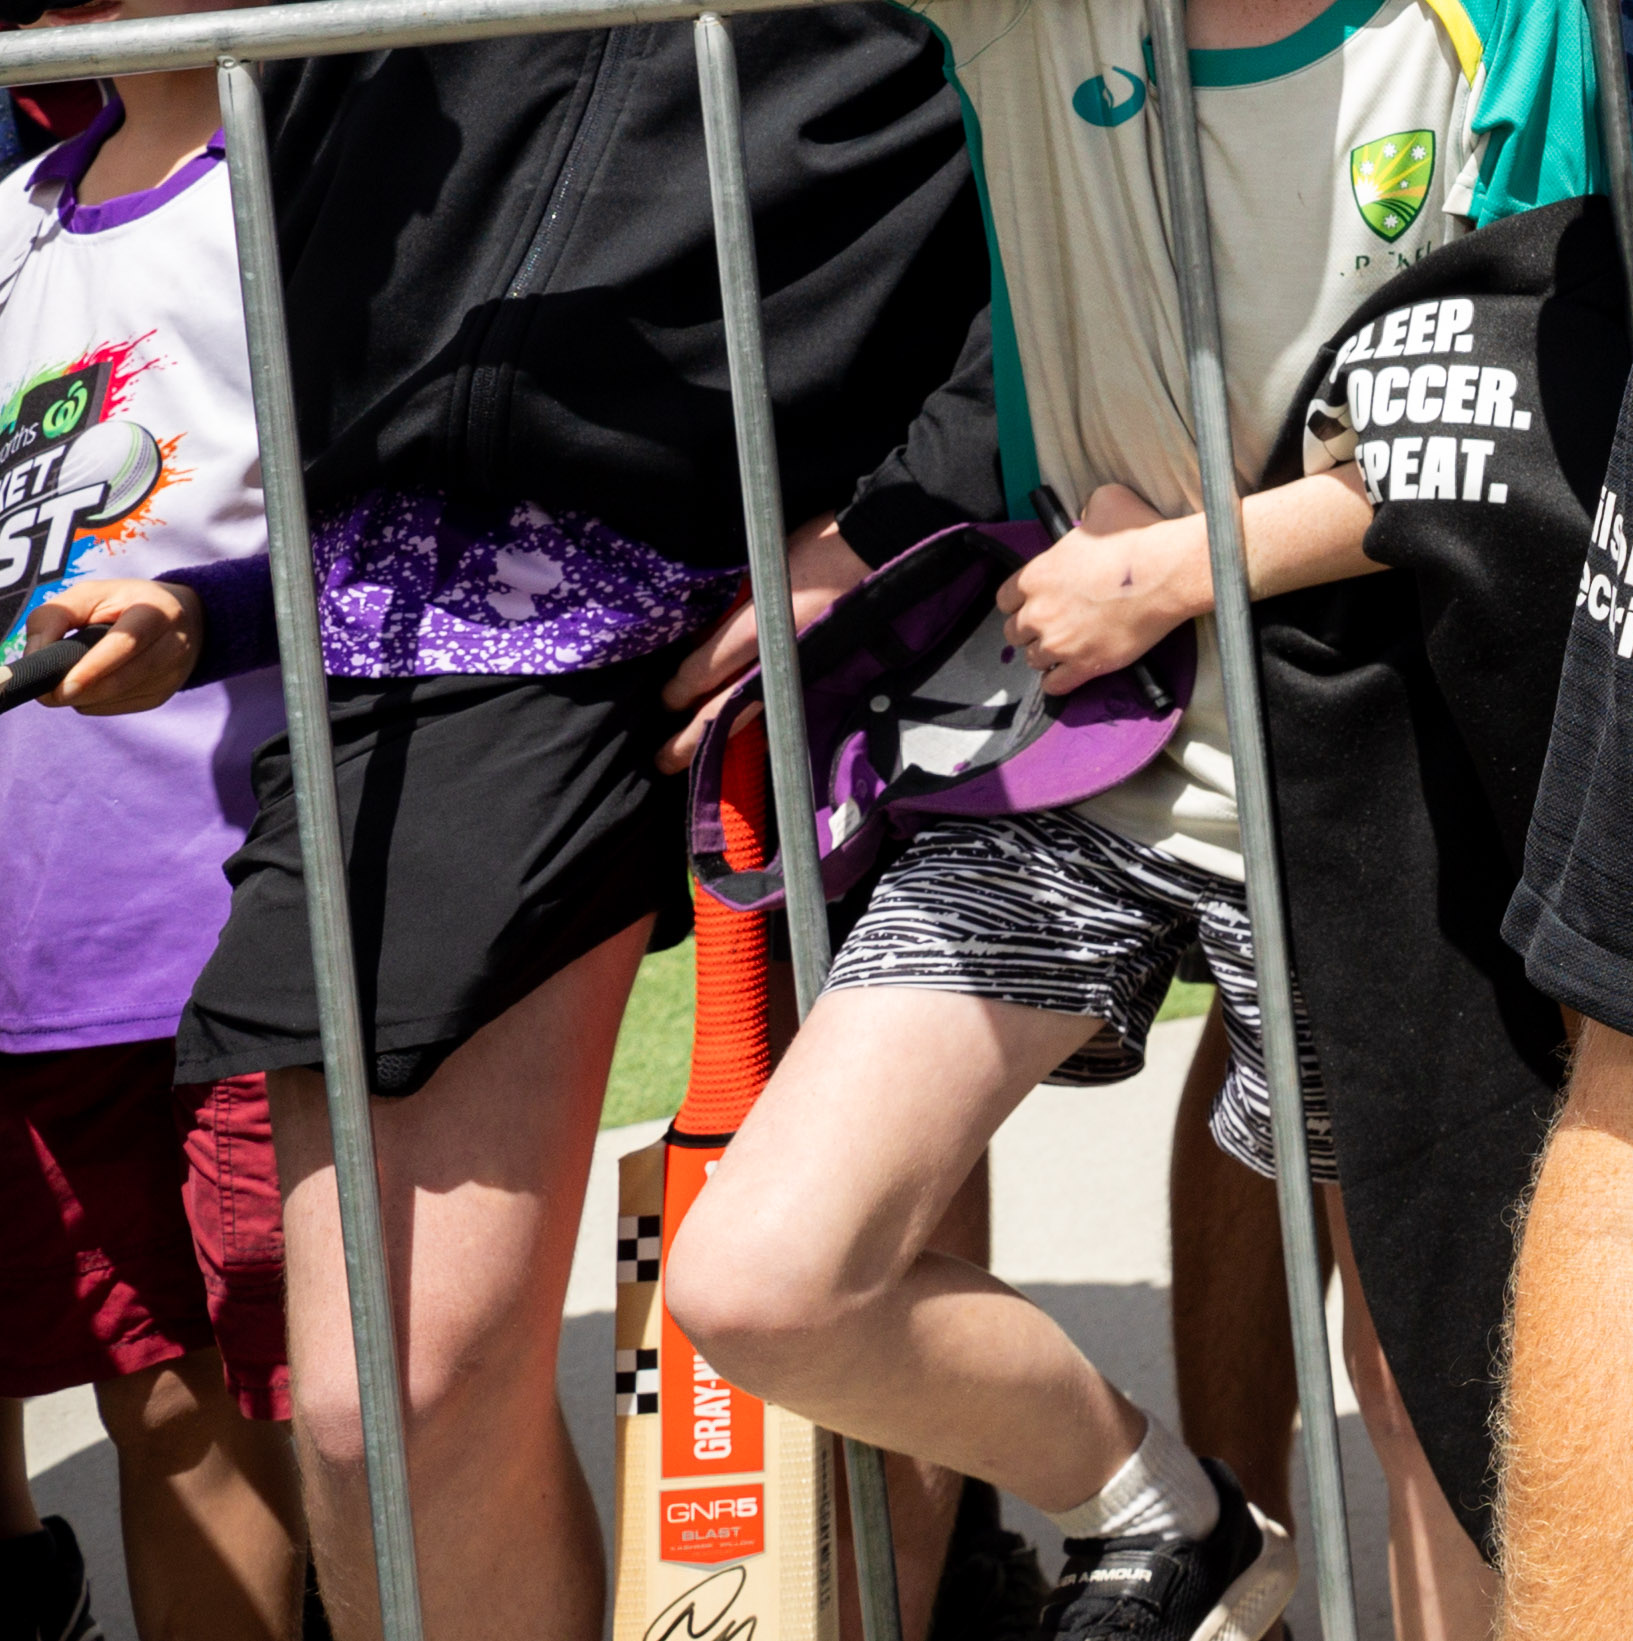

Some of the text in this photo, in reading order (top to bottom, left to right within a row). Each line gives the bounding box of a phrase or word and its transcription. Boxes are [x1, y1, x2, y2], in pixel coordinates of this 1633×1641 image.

[1346, 363, 1533, 432] OCCER.
[1354, 436, 1510, 505] PEAT.
[693, 1354, 732, 1461] GRAY-N
[666, 1496, 758, 1524] GNR5
[681, 1526, 741, 1542] BLAST
